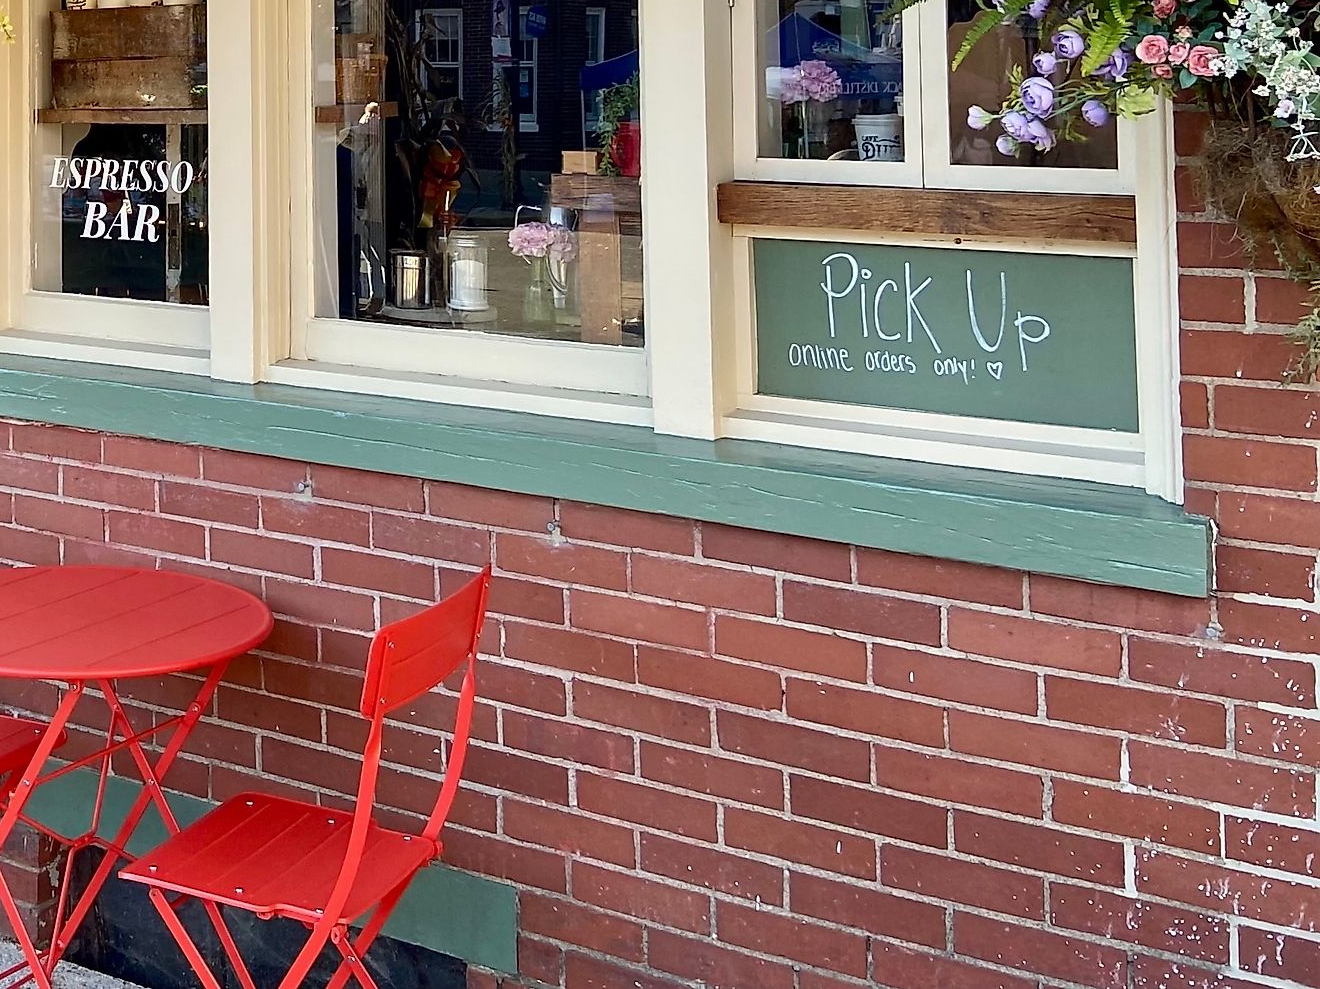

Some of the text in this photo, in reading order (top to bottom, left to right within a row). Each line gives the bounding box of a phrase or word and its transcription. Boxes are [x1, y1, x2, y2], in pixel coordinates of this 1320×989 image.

[49, 157, 194, 194] ESPRESSO
[80, 199, 161, 243] BAR
[965, 268, 1051, 372] Up
[788, 343, 977, 386] online orders only!
